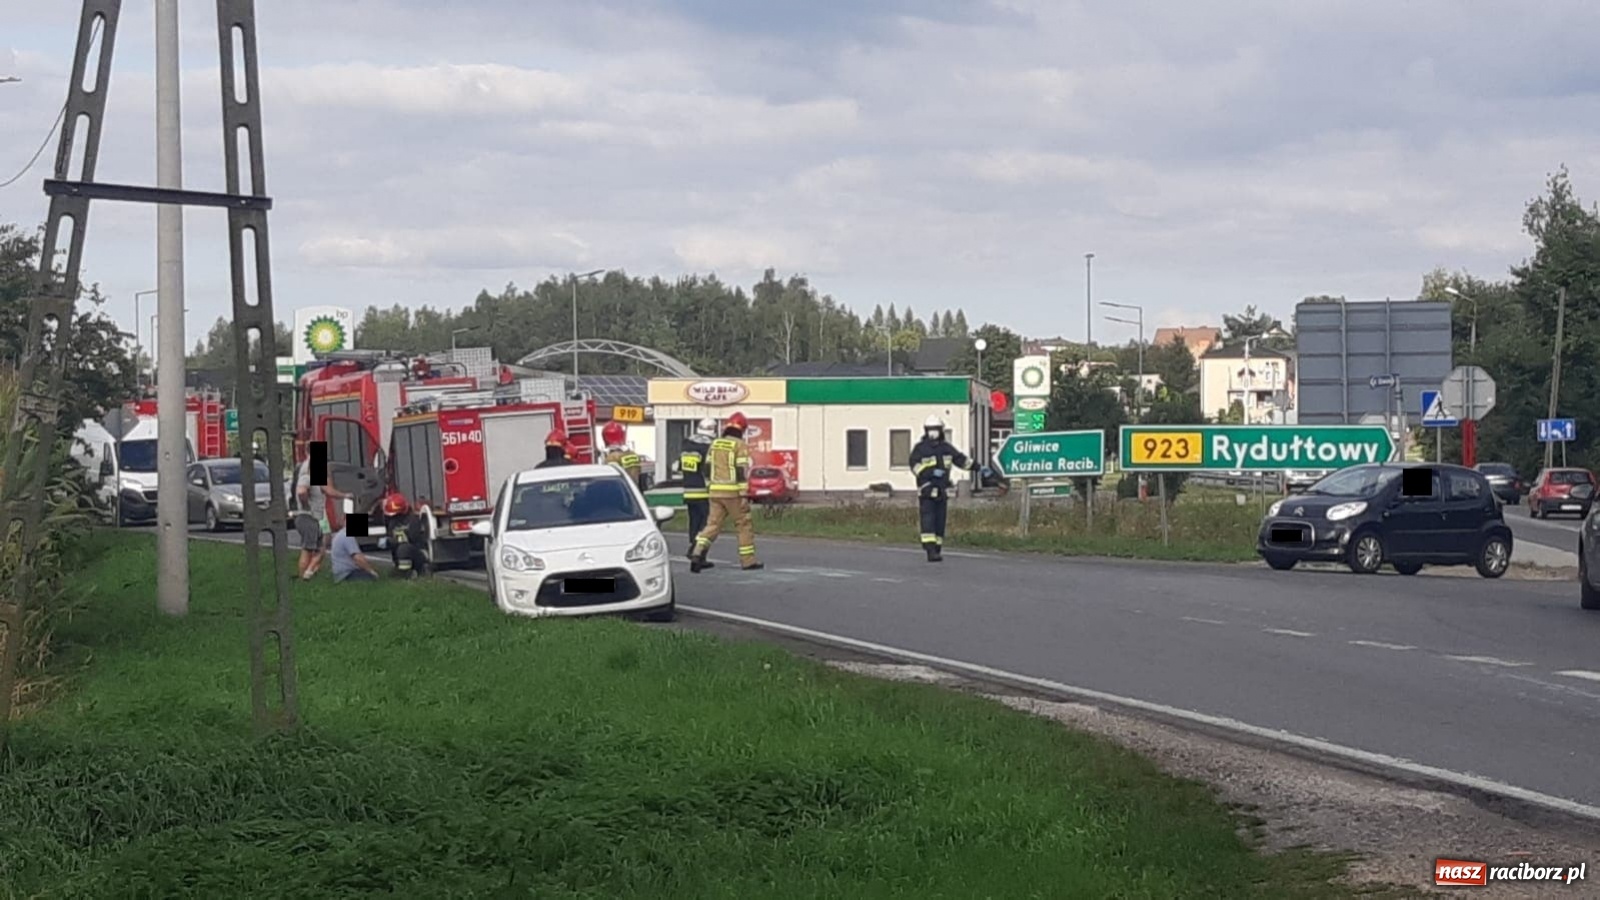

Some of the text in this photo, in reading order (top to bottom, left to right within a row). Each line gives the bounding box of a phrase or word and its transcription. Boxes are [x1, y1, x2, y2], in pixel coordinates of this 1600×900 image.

[619, 409, 637, 418] 919
[1013, 440, 1059, 453] Gliwice
[1143, 434, 1378, 469] 923 Rydułtowy
[1011, 456, 1098, 471] Kuźnia Racib.
